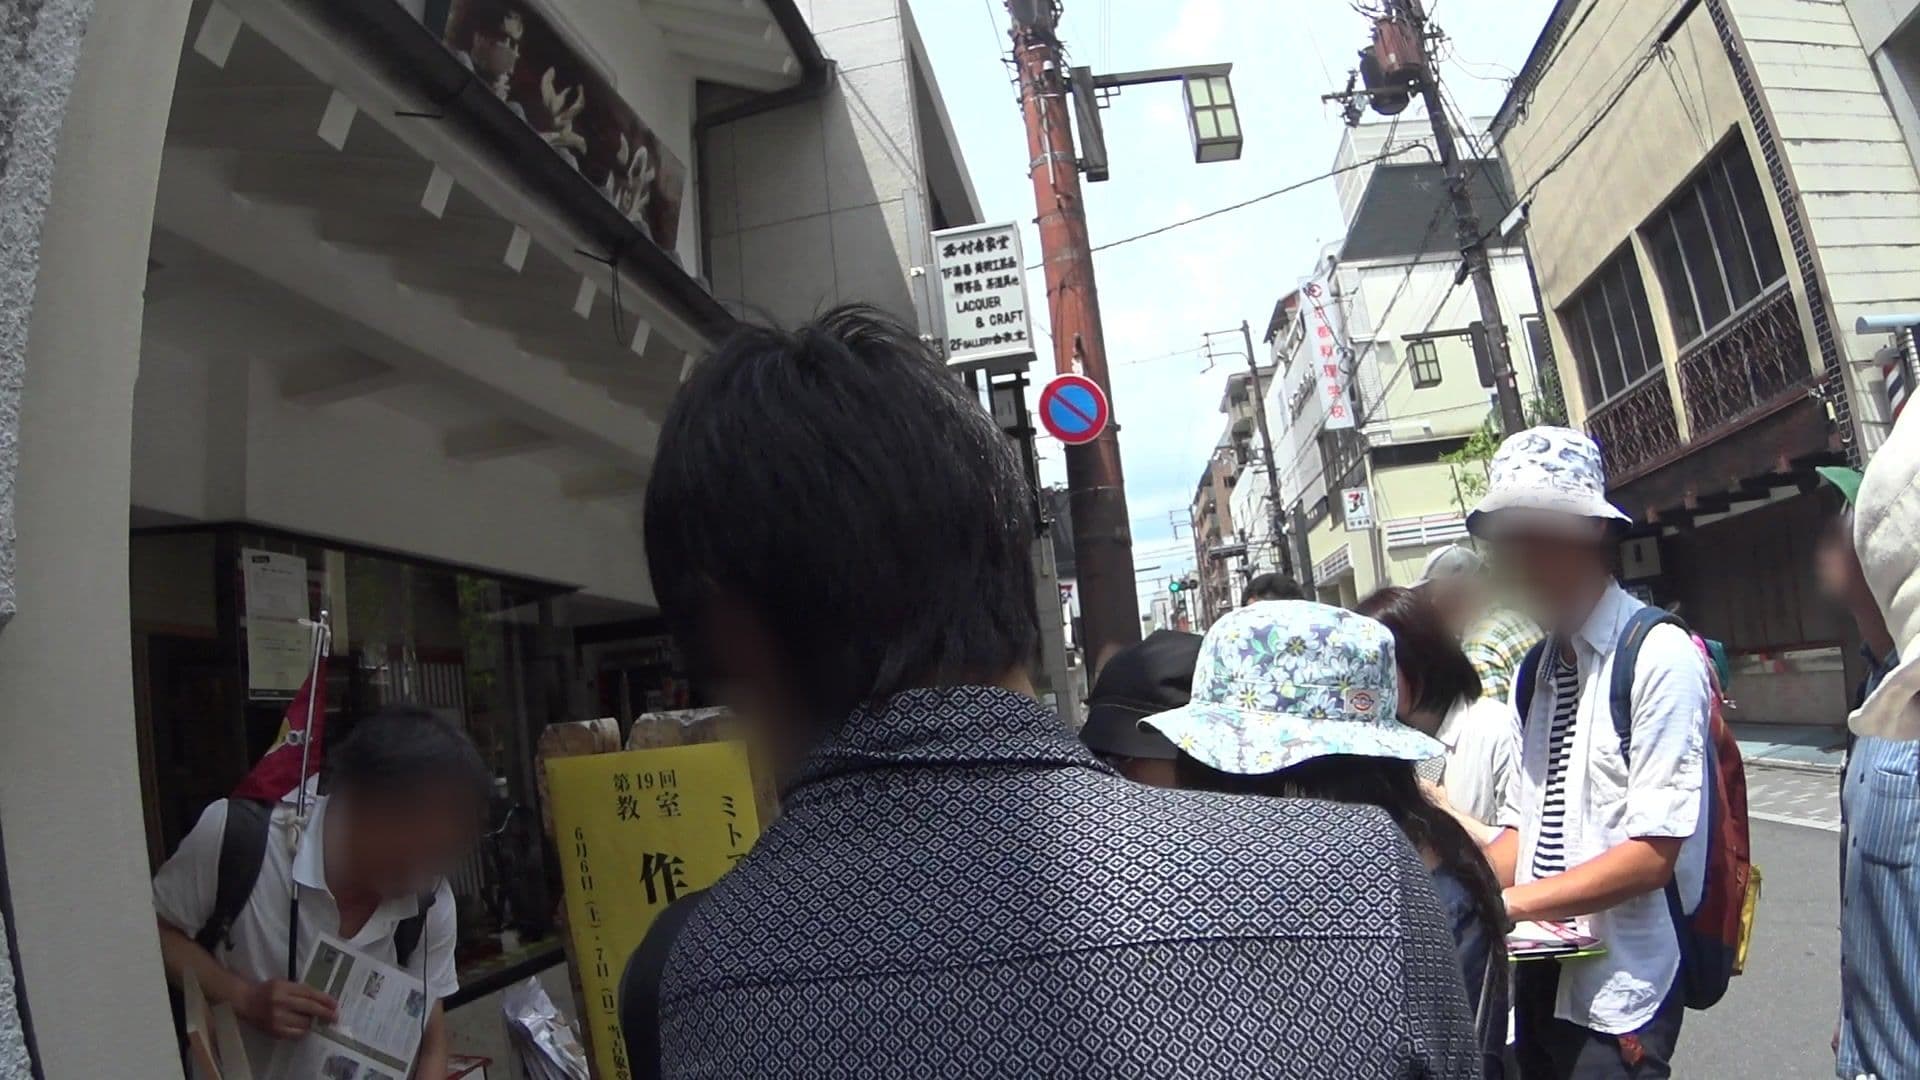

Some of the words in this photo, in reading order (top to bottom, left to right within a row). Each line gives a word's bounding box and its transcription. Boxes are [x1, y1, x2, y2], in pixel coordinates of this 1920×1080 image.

[956, 296, 1001, 313] LACQUER
[975, 316, 985, 328] &
[989, 310, 1024, 326] CRAFT
[613, 769, 677, 793] 第19回
[617, 792, 682, 820] 教室
[640, 852, 689, 905] 作
